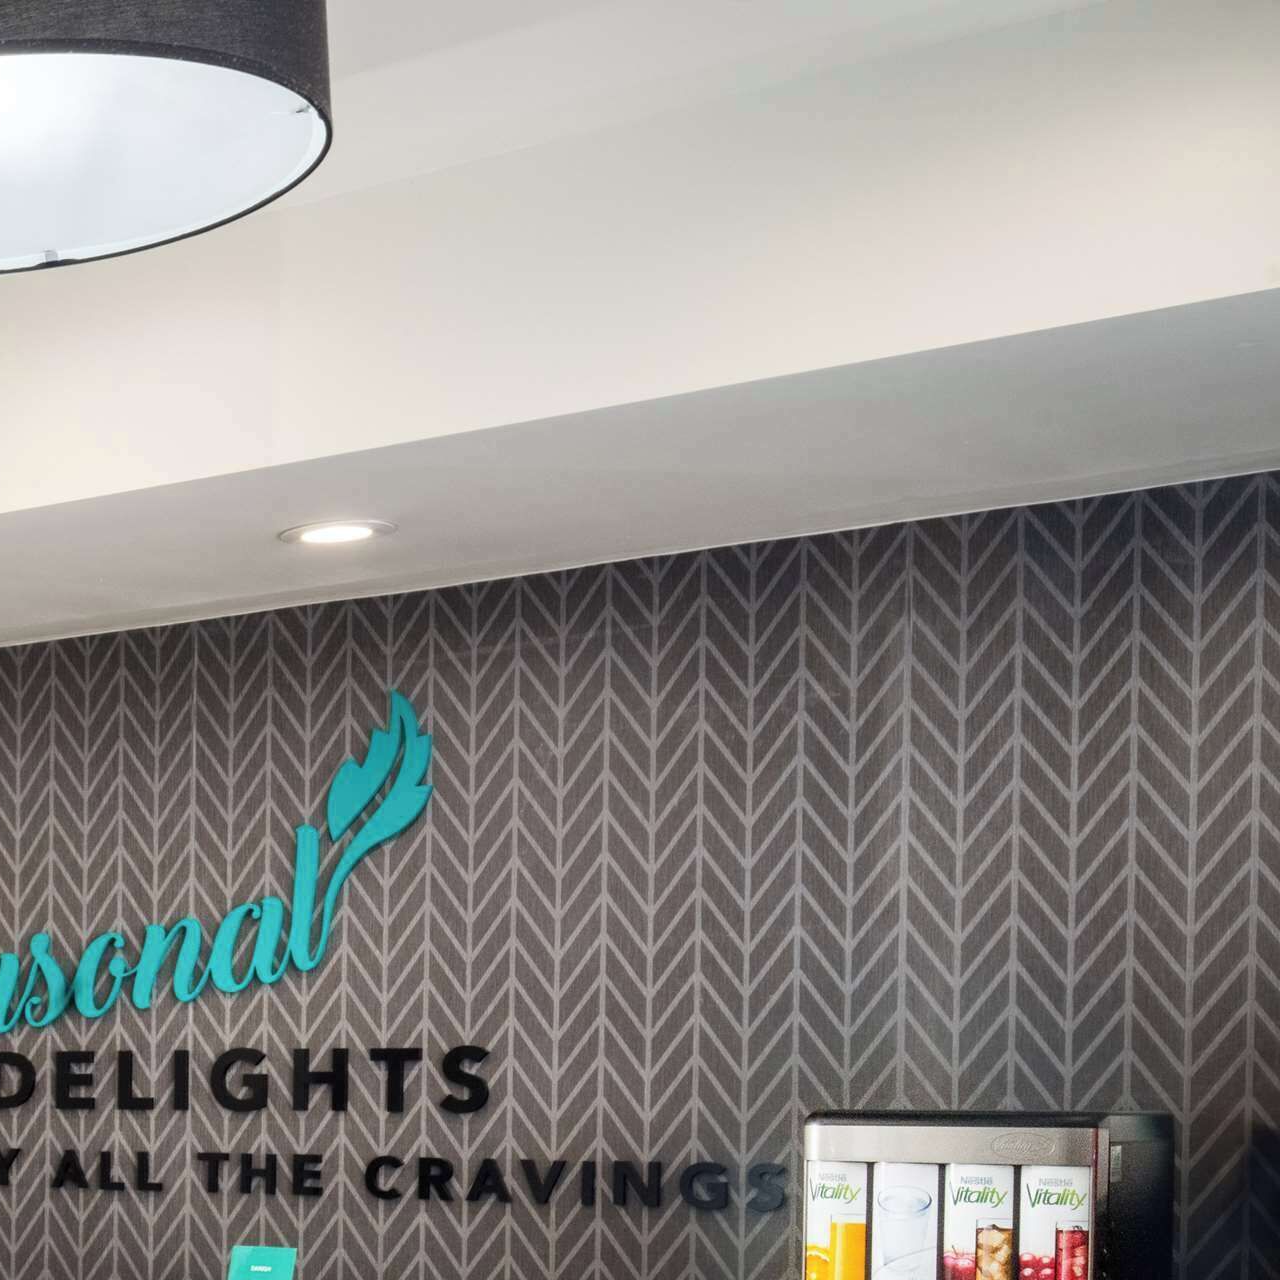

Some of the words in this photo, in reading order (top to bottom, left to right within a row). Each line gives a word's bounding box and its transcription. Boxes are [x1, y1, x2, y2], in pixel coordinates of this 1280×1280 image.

[51, 1149, 163, 1191] ALL
[196, 1152, 324, 1195] THE
[364, 1156, 788, 1212] CRAVINGS
